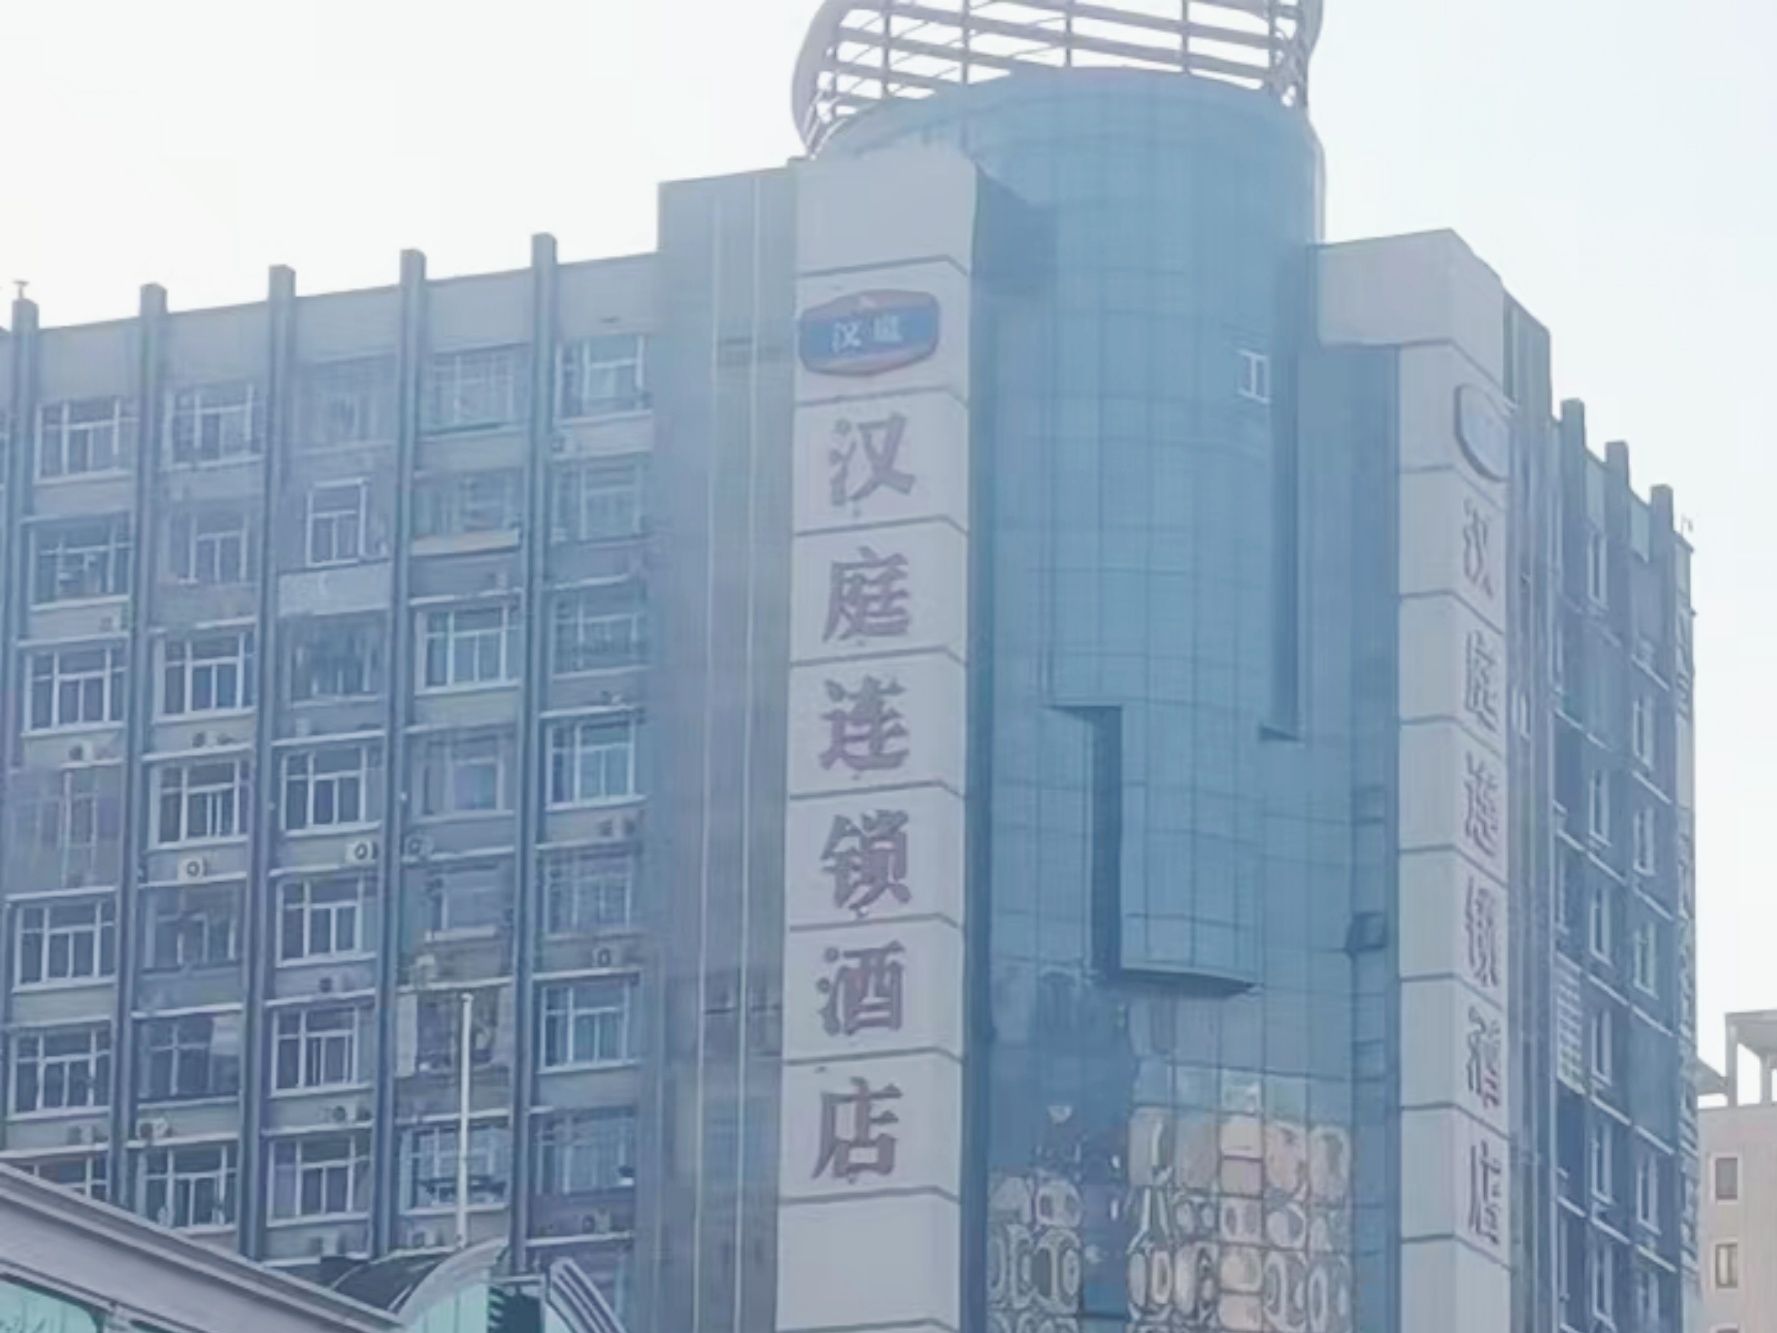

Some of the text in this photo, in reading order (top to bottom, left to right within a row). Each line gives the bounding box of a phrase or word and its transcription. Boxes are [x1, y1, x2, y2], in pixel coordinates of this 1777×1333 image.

[811, 412, 917, 1181] 汉庭连锁酒店
[1462, 498, 1501, 1246] 汉庭连锁酒店
